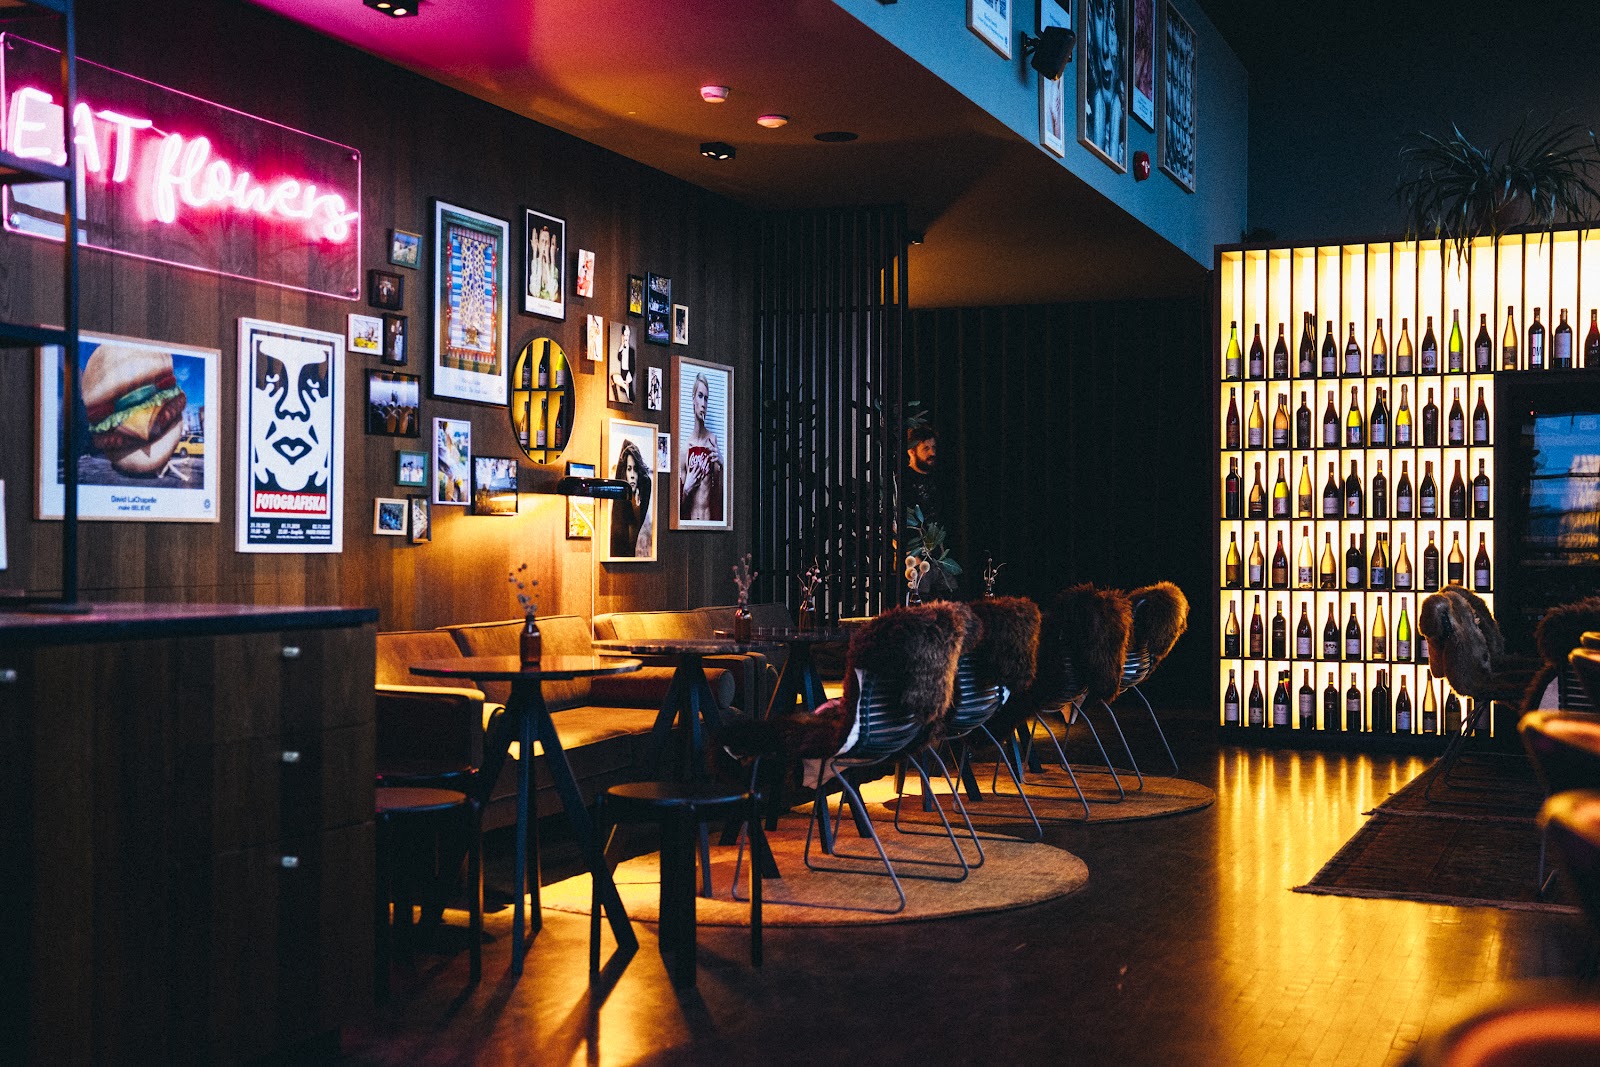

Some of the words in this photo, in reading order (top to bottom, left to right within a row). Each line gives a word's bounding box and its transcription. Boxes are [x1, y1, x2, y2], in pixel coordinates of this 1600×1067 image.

[13, 86, 152, 183] EAT
[153, 132, 359, 242] flowers
[255, 492, 327, 512] FOTOGRAFISKA
